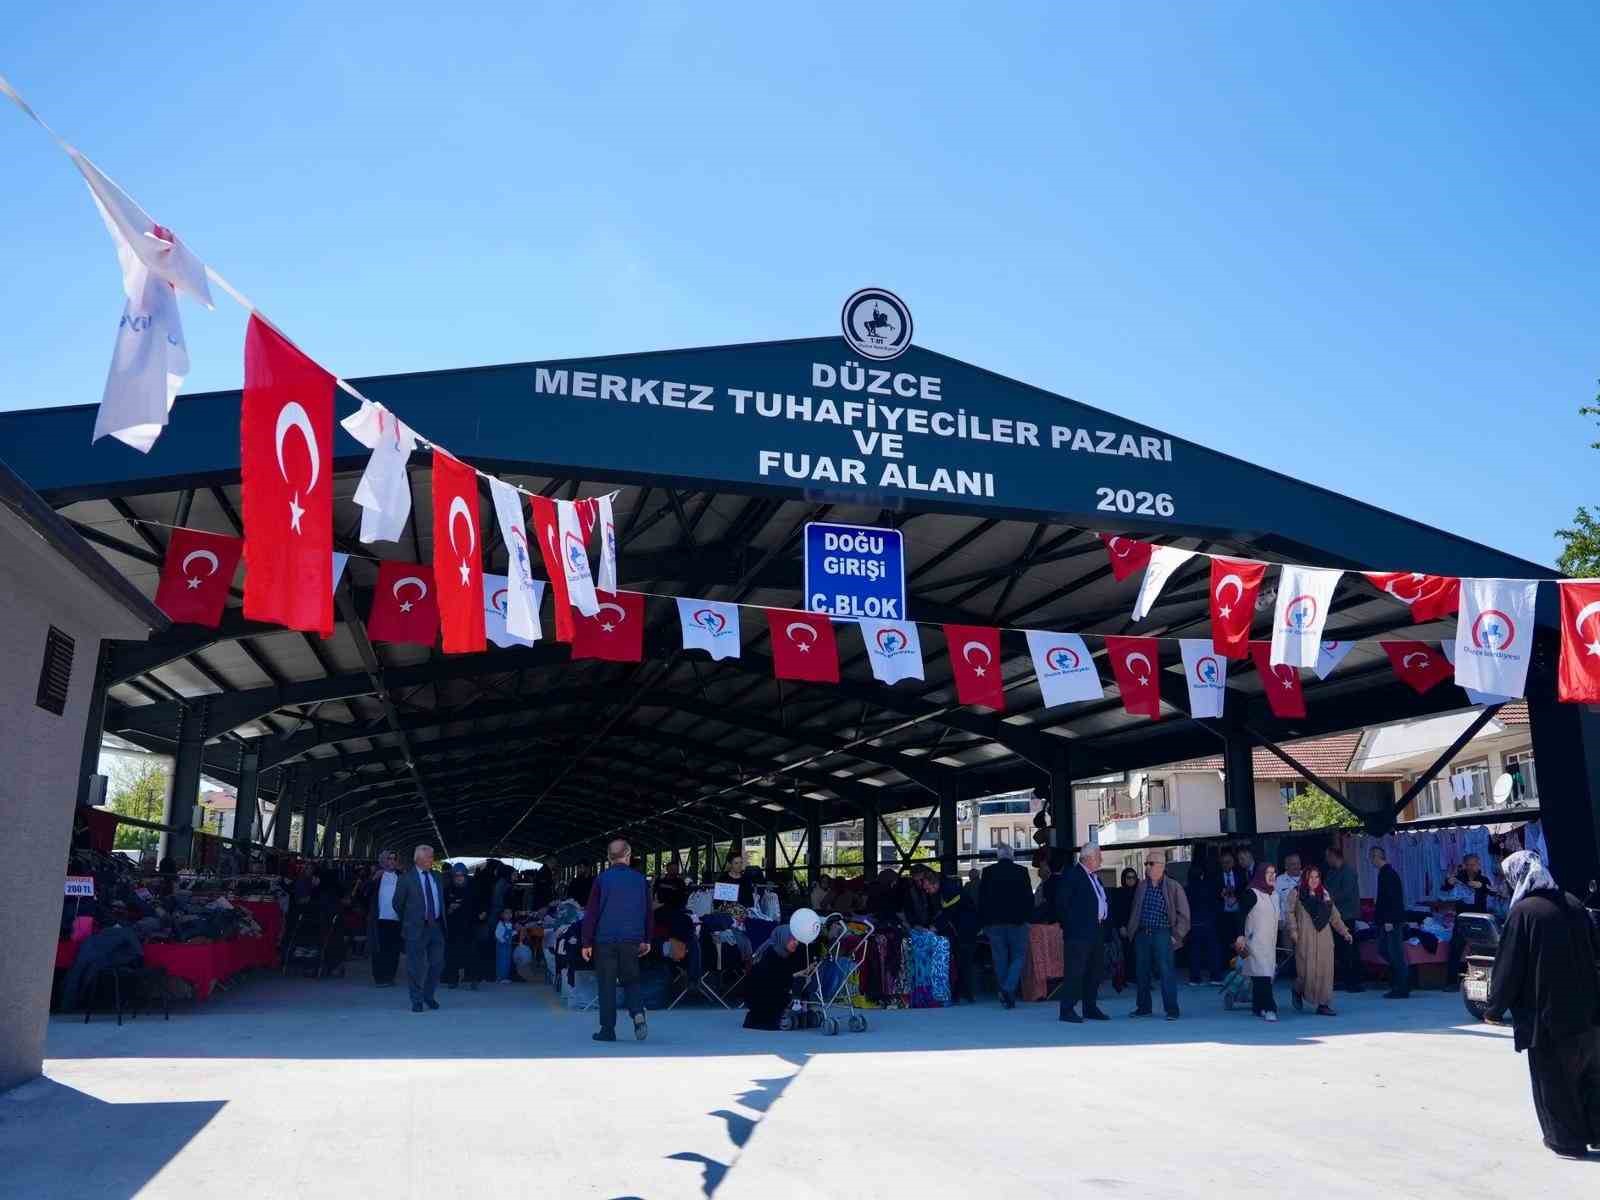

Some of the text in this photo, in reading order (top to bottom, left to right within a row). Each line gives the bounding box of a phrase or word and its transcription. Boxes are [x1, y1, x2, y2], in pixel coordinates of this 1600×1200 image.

[812, 362, 942, 400] DÜZCE
[535, 368, 1172, 462] MERKEZ TUHAFİYECİLER PAZARI
[853, 430, 904, 459] VE
[759, 451, 995, 497] FUAR ALANI
[1096, 487, 1174, 517] 2026
[824, 532, 884, 555] DOĞU
[811, 593, 898, 619] C.BLOK
